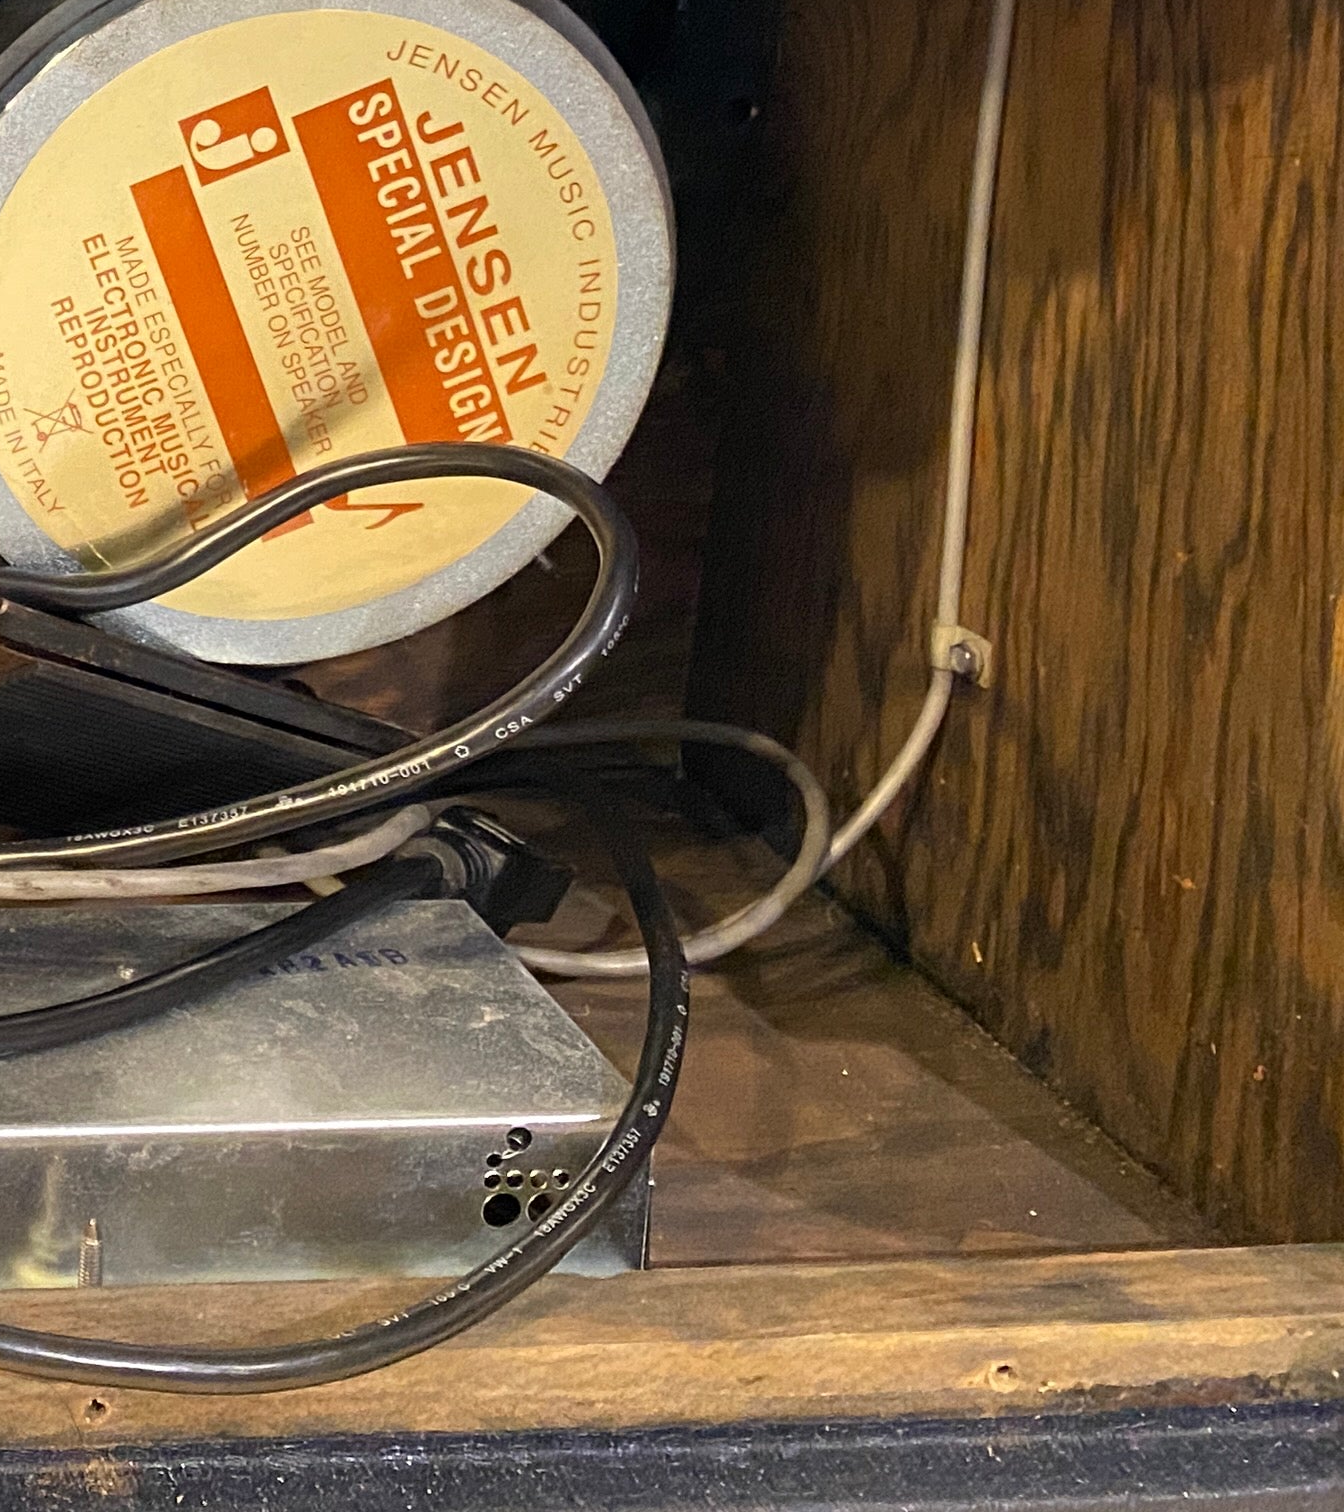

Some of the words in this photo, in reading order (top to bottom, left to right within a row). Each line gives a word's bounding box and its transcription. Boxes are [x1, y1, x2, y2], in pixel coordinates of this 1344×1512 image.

[386, 39, 530, 126] JENSEN
[528, 129, 596, 243] MUSIC
[230, 213, 281, 313] NUMBER
[267, 315, 295, 350] ON
[268, 241, 344, 410] SPECIFICATION
[290, 225, 322, 275] SEE
[308, 275, 348, 357] MODEL
[336, 359, 369, 406] AND
[348, 92, 416, 280] SPECIAL
[414, 284, 503, 444] DESIGN
[50, 295, 150, 511] REPRODUCTION
[82, 232, 165, 407] ELECTRONIC
[150, 413, 210, 533] MUSICAL
[83, 305, 169, 477] INSTRUMENT
[115, 234, 158, 307] MADE
[143, 311, 216, 453] ESPECIALLY
[198, 457, 234, 511] FOR
[280, 352, 334, 458] SPEAKER
[3, 430, 27, 454] IN
[16, 458, 68, 515] ITALY
[494, 714, 533, 742] CSA
[552, 672, 585, 704] SVT
[533, 1183, 597, 1239] 18AWGX3C
[601, 1126, 643, 1175] E137357
[656, 1025, 684, 1087] 191710-001
